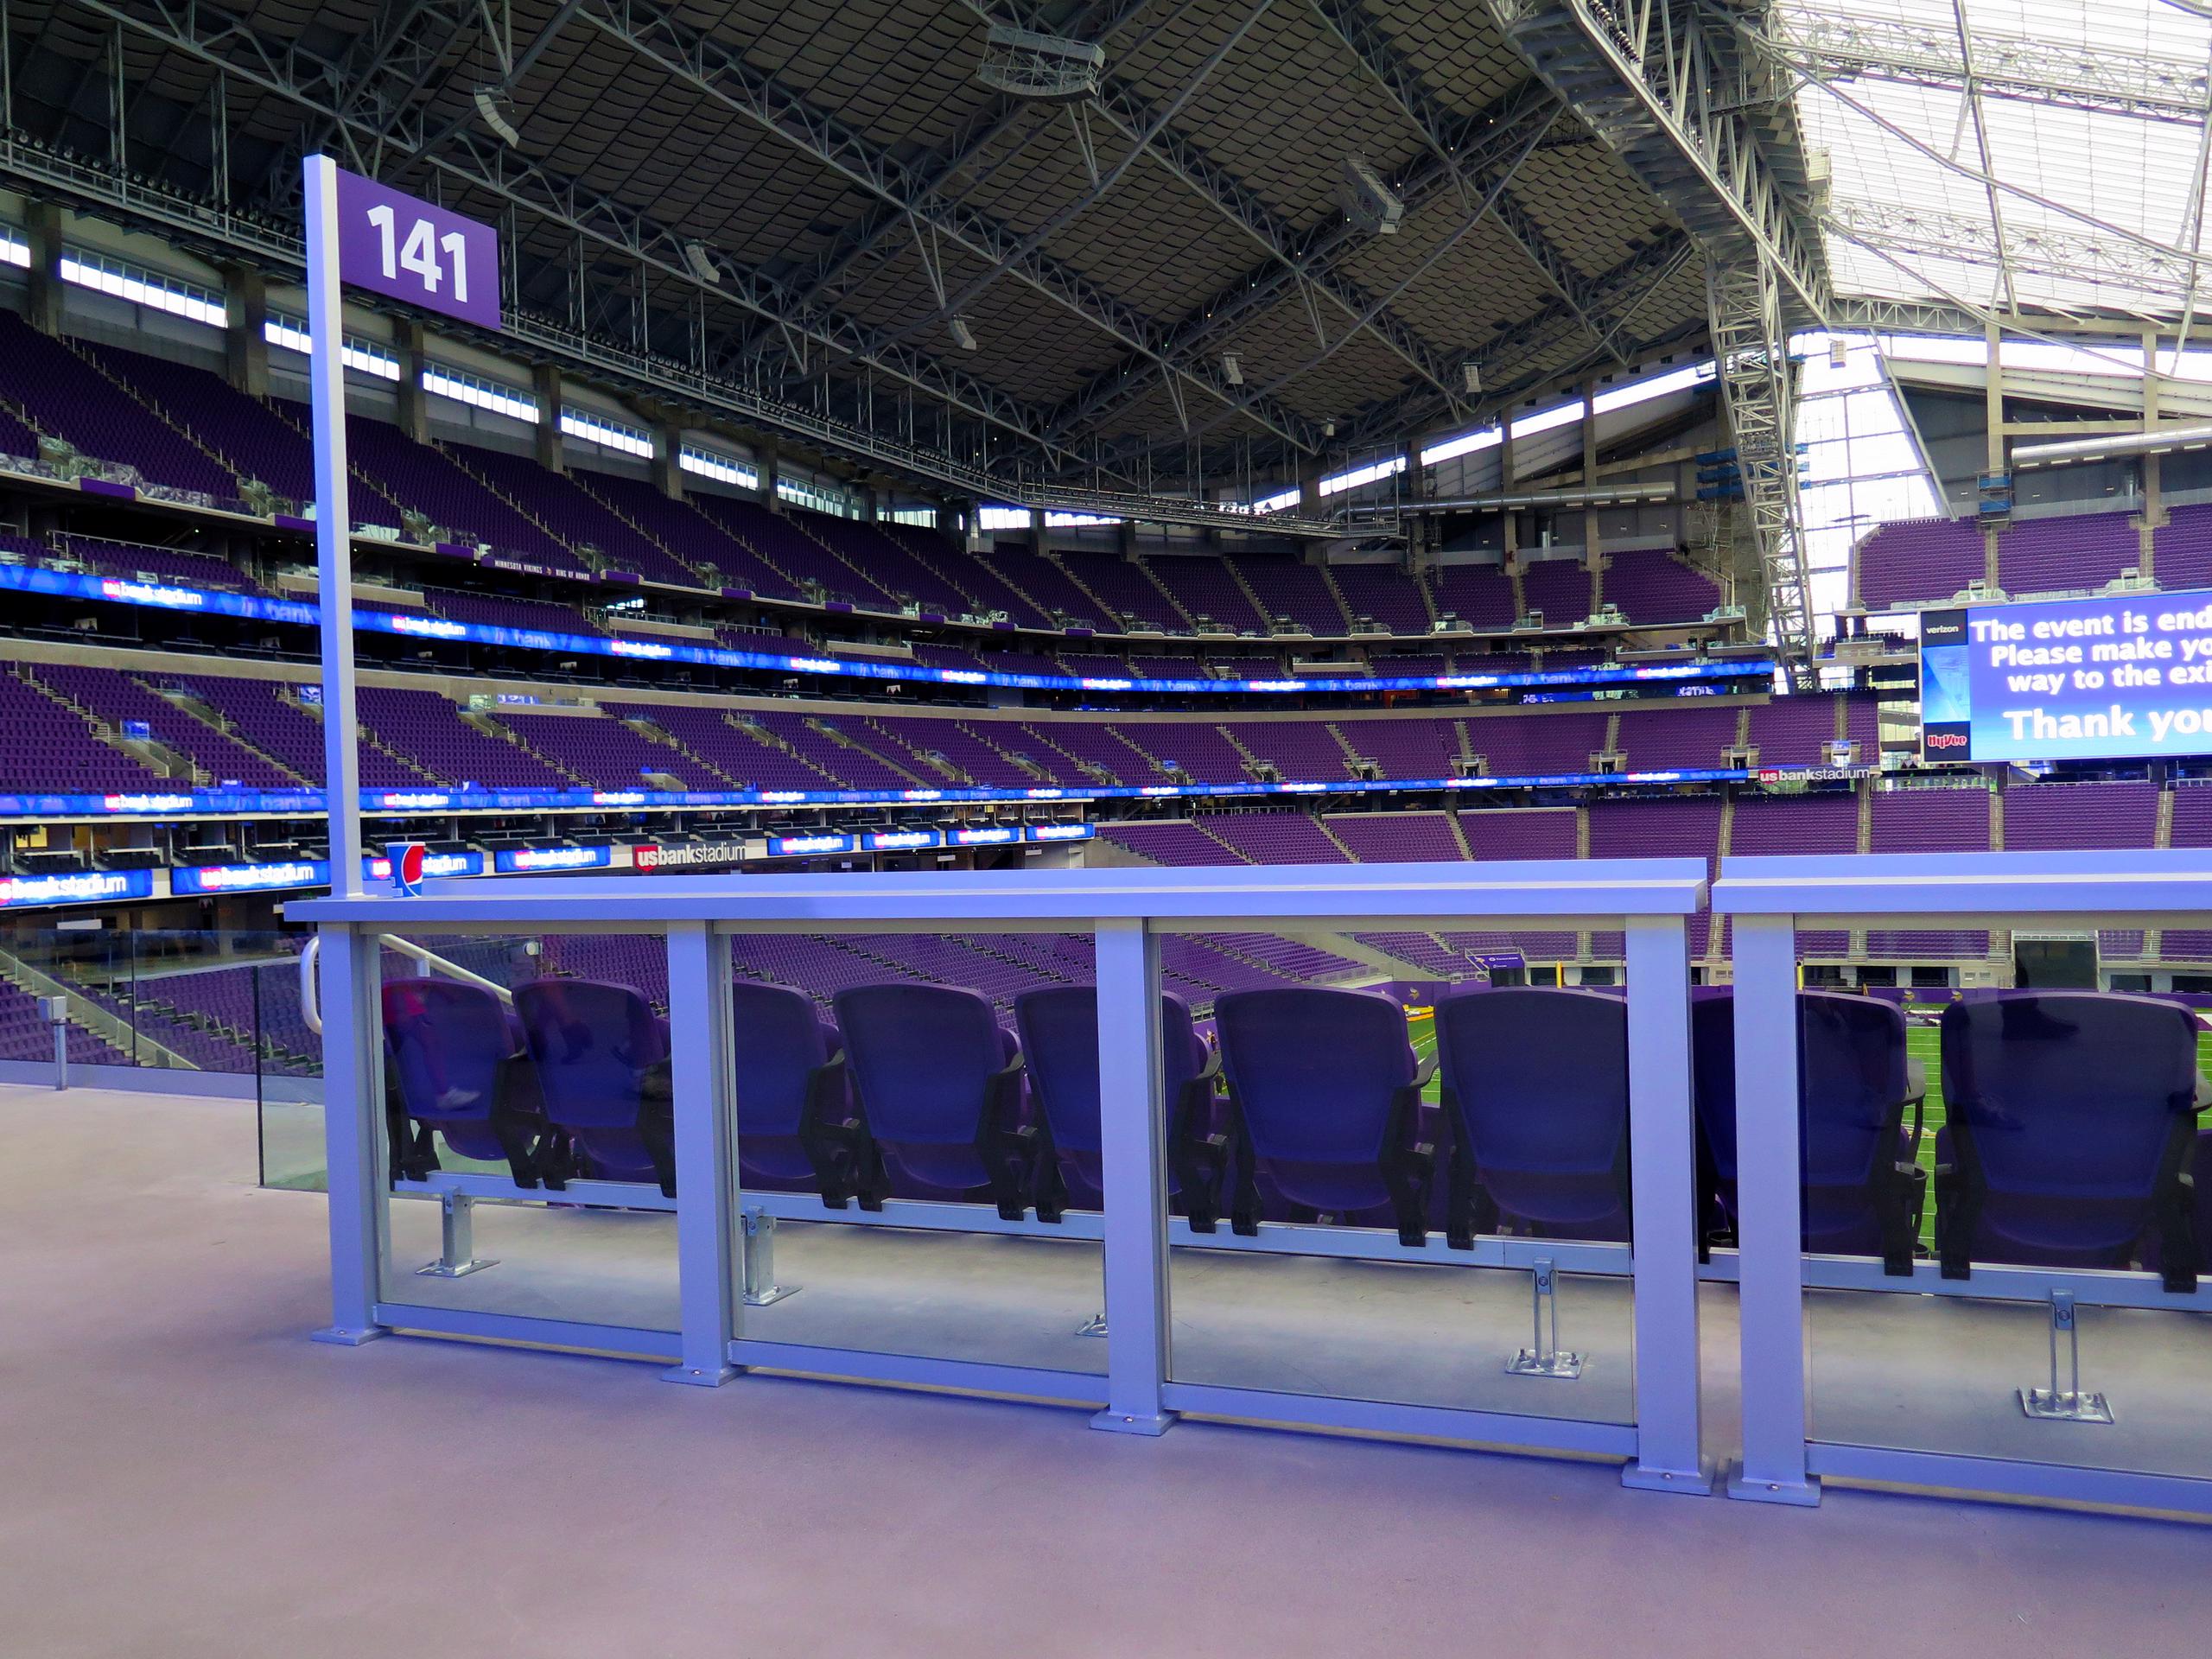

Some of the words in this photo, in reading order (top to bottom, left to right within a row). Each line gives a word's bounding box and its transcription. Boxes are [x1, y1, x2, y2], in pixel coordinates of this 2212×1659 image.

[366, 204, 467, 303] 141
[524, 564, 543, 574] VIKINGS
[1926, 624, 1959, 635] verizon
[1970, 619, 2025, 642] The
[2033, 613, 2114, 638] event
[2123, 610, 2149, 633] is
[1991, 644, 2083, 668] Please
[2092, 636, 2172, 662] make
[2007, 671, 2066, 695] way
[2073, 669, 2105, 689] to
[2112, 664, 2161, 688] the
[2003, 704, 2137, 741] Thank
